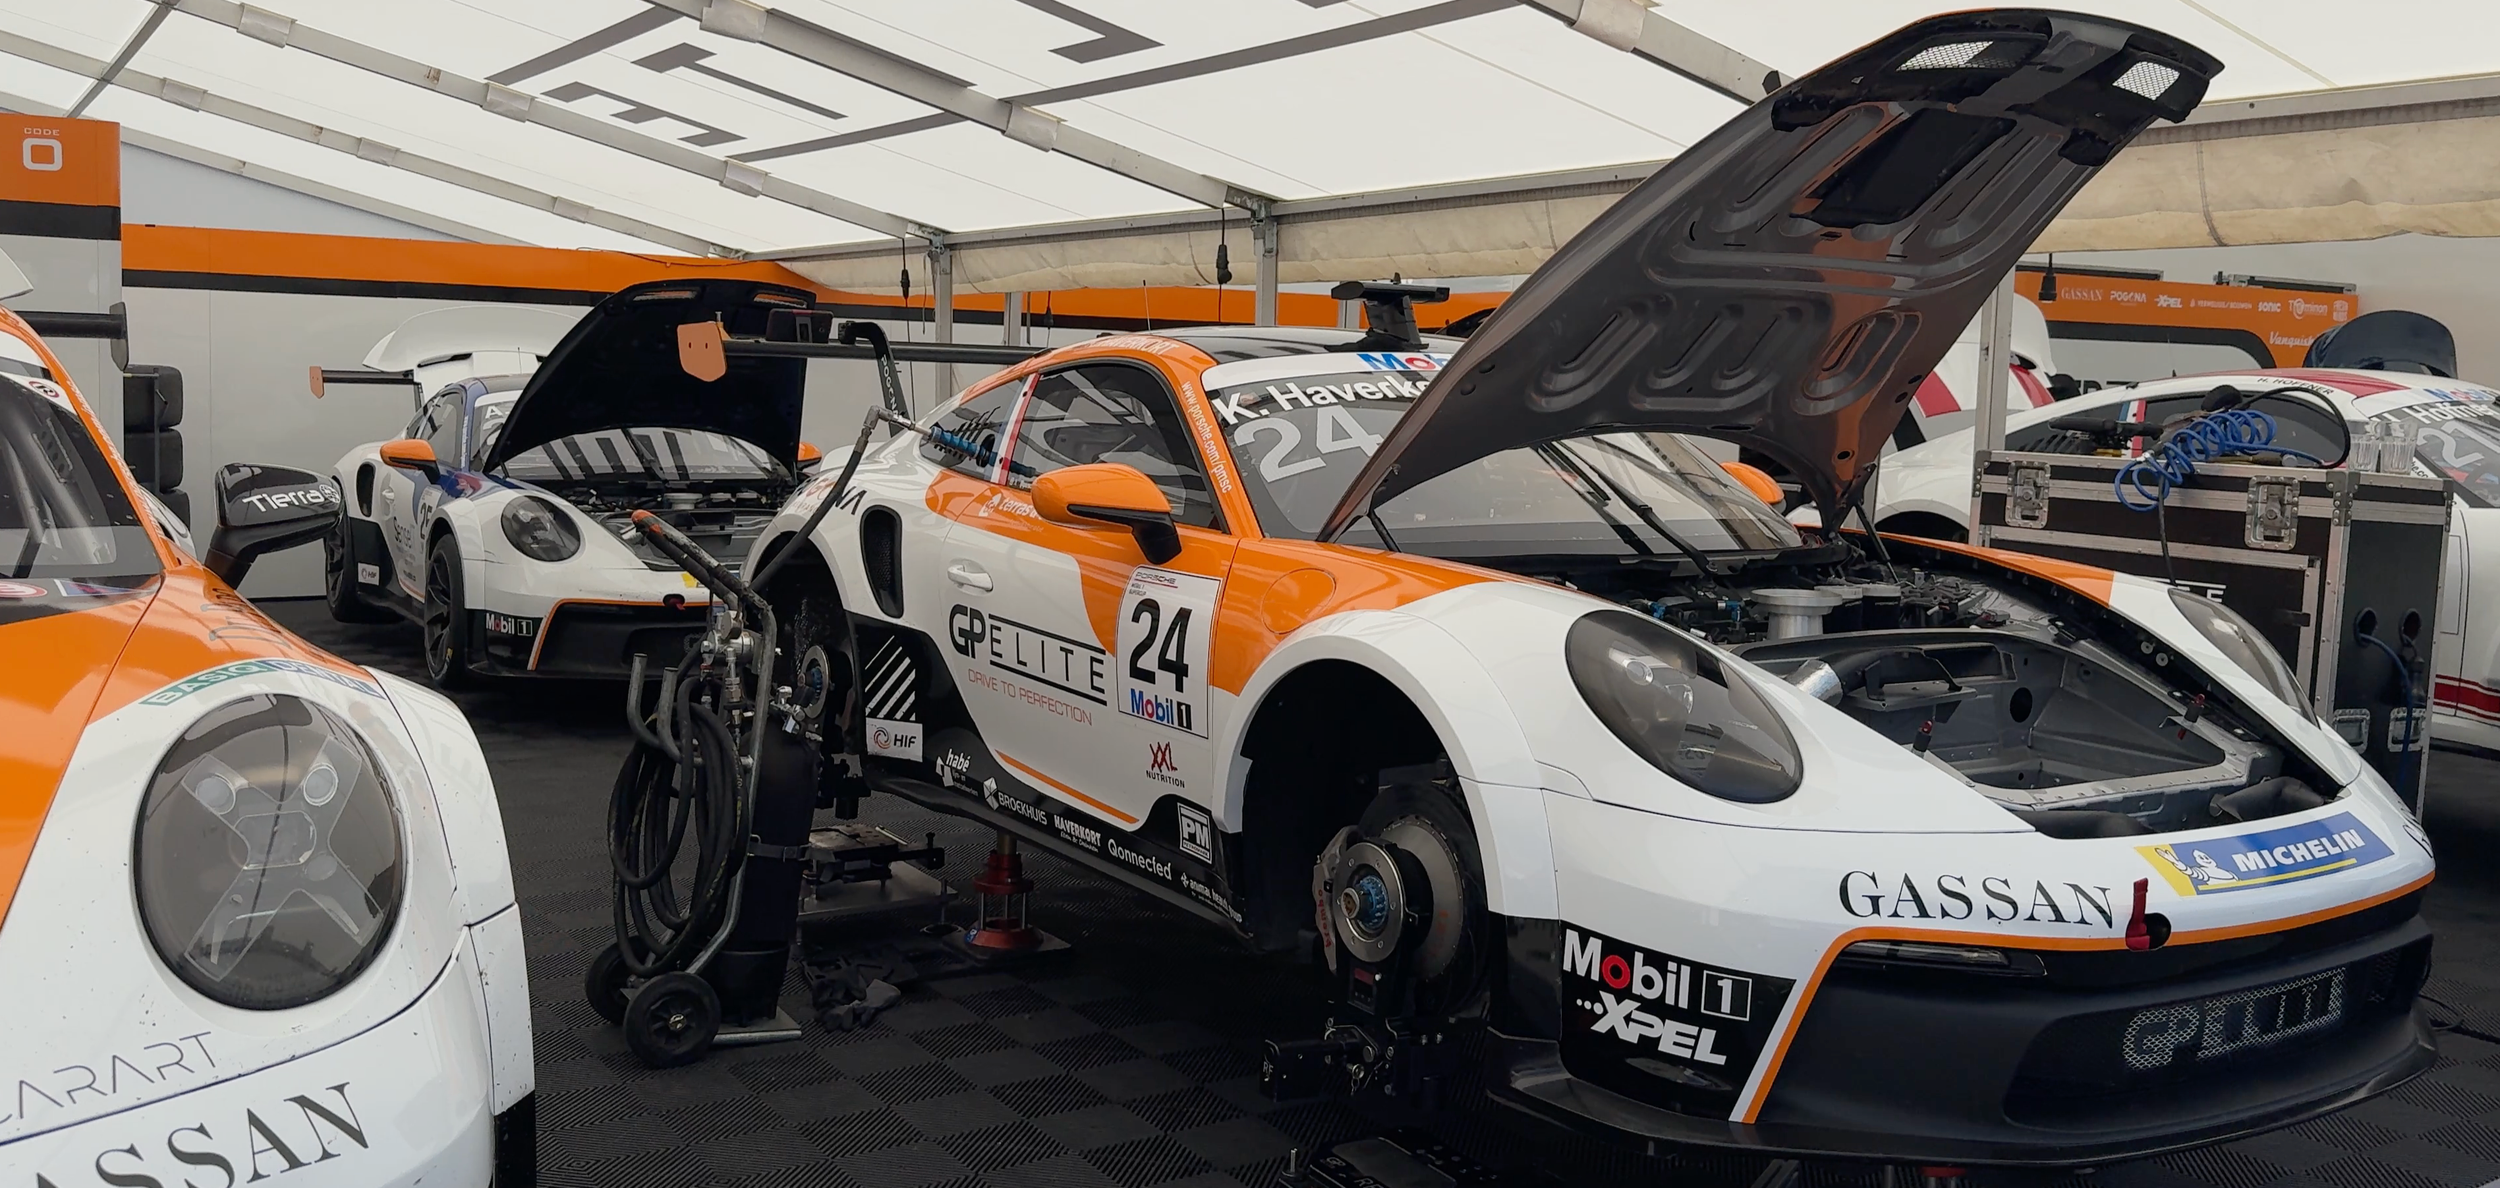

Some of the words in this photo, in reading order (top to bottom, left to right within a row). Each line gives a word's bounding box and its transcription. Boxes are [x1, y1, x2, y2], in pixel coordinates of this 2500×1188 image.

[24, 127, 60, 136] CODE
[2061, 286, 2103, 301] GASSAN
[1211, 391, 1271, 426] K.
[1181, 380, 1232, 494] www.porsche.com/pmsc
[1233, 404, 1384, 483] 24
[1135, 571, 1177, 584] PORSCHE
[486, 613, 515, 635] Mobil
[989, 622, 1106, 695] ELITE
[1129, 597, 1193, 693] 24
[152, 661, 269, 702] BASIQ
[968, 668, 998, 692] DRIVE
[1001, 680, 1017, 698] TO
[1019, 687, 1092, 726] PERFECTION
[1130, 687, 1175, 725] Mobil
[893, 733, 917, 748] HIF
[1149, 741, 1178, 773] XXL
[946, 748, 971, 772] habé
[1145, 769, 1186, 788] NUTRITION
[998, 791, 1048, 825] BROEKHUIS
[1053, 814, 1102, 847] HAVERKORT
[1181, 815, 1210, 850] PM
[1107, 838, 1173, 881] Qonnected
[2231, 828, 2366, 872] MICHELIN
[1838, 870, 2114, 929] GASSAN
[1562, 928, 1691, 1010] Mobil
[1590, 990, 1728, 1066] XPEL
